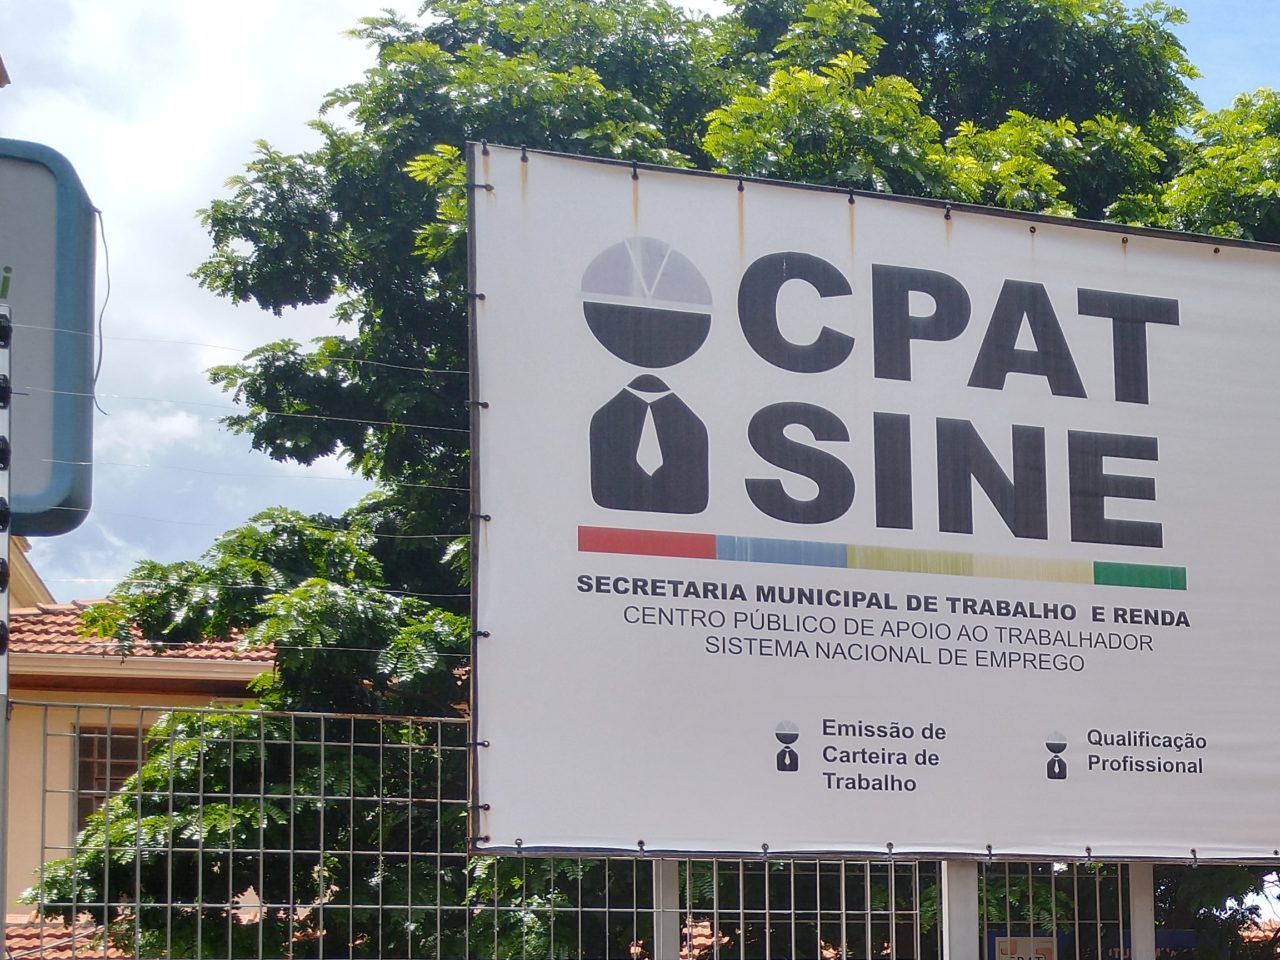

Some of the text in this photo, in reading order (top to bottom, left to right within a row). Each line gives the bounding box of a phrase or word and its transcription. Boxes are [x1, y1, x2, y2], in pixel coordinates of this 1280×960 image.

[737, 251, 1180, 405] CPAT
[744, 400, 1164, 549] SINE
[576, 574, 1191, 627] SECRETARIA MUNICIPAL DE TRABALHO E RENDA
[623, 605, 1154, 652] CENTRO PÚBLICO DE APOIO AO TRABALHADOR
[705, 635, 1085, 672] SISTEMA NACIONAL DE EMPREGO
[822, 718, 946, 740] Emissão de
[1087, 729, 1207, 752] Qualificação
[822, 745, 940, 766] Carteira de
[1088, 754, 1204, 774] Profissional
[822, 772, 917, 792] Trabalho
